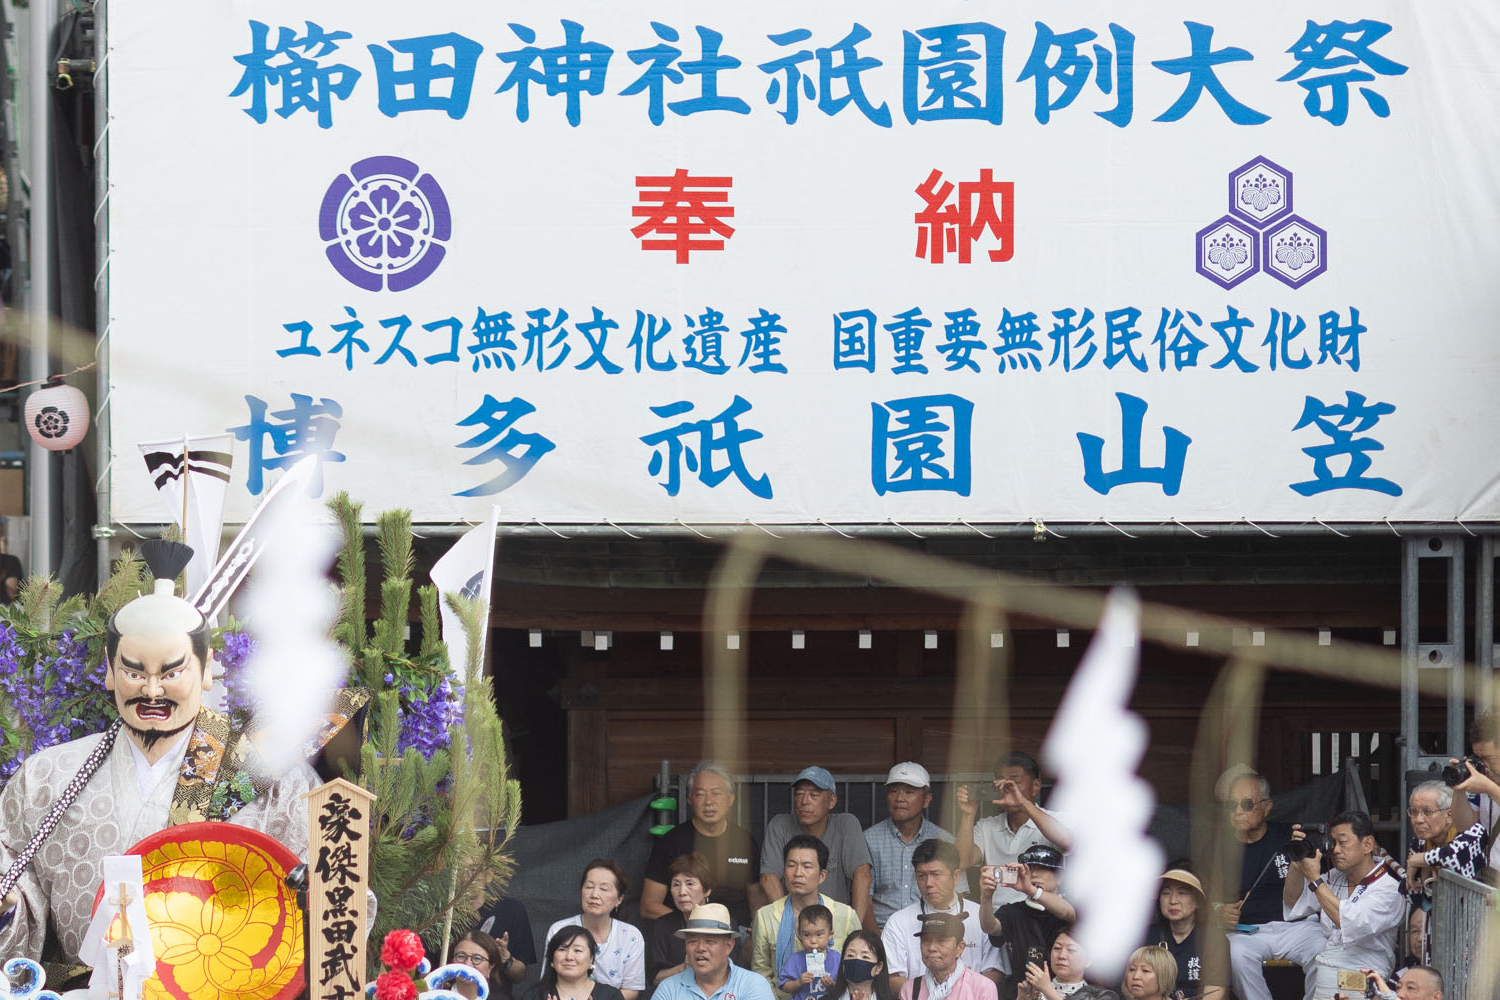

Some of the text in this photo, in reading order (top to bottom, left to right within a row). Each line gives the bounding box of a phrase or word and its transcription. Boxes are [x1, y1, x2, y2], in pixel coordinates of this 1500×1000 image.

[228, 18, 1409, 130] 櫛田神社祇園例大祭
[275, 305, 1368, 375] ユネスコ無形文化遺産 国重要無形民俗文化財
[226, 391, 1403, 500] 博多祇園山笠
[1187, 957, 1202, 981] 救護
